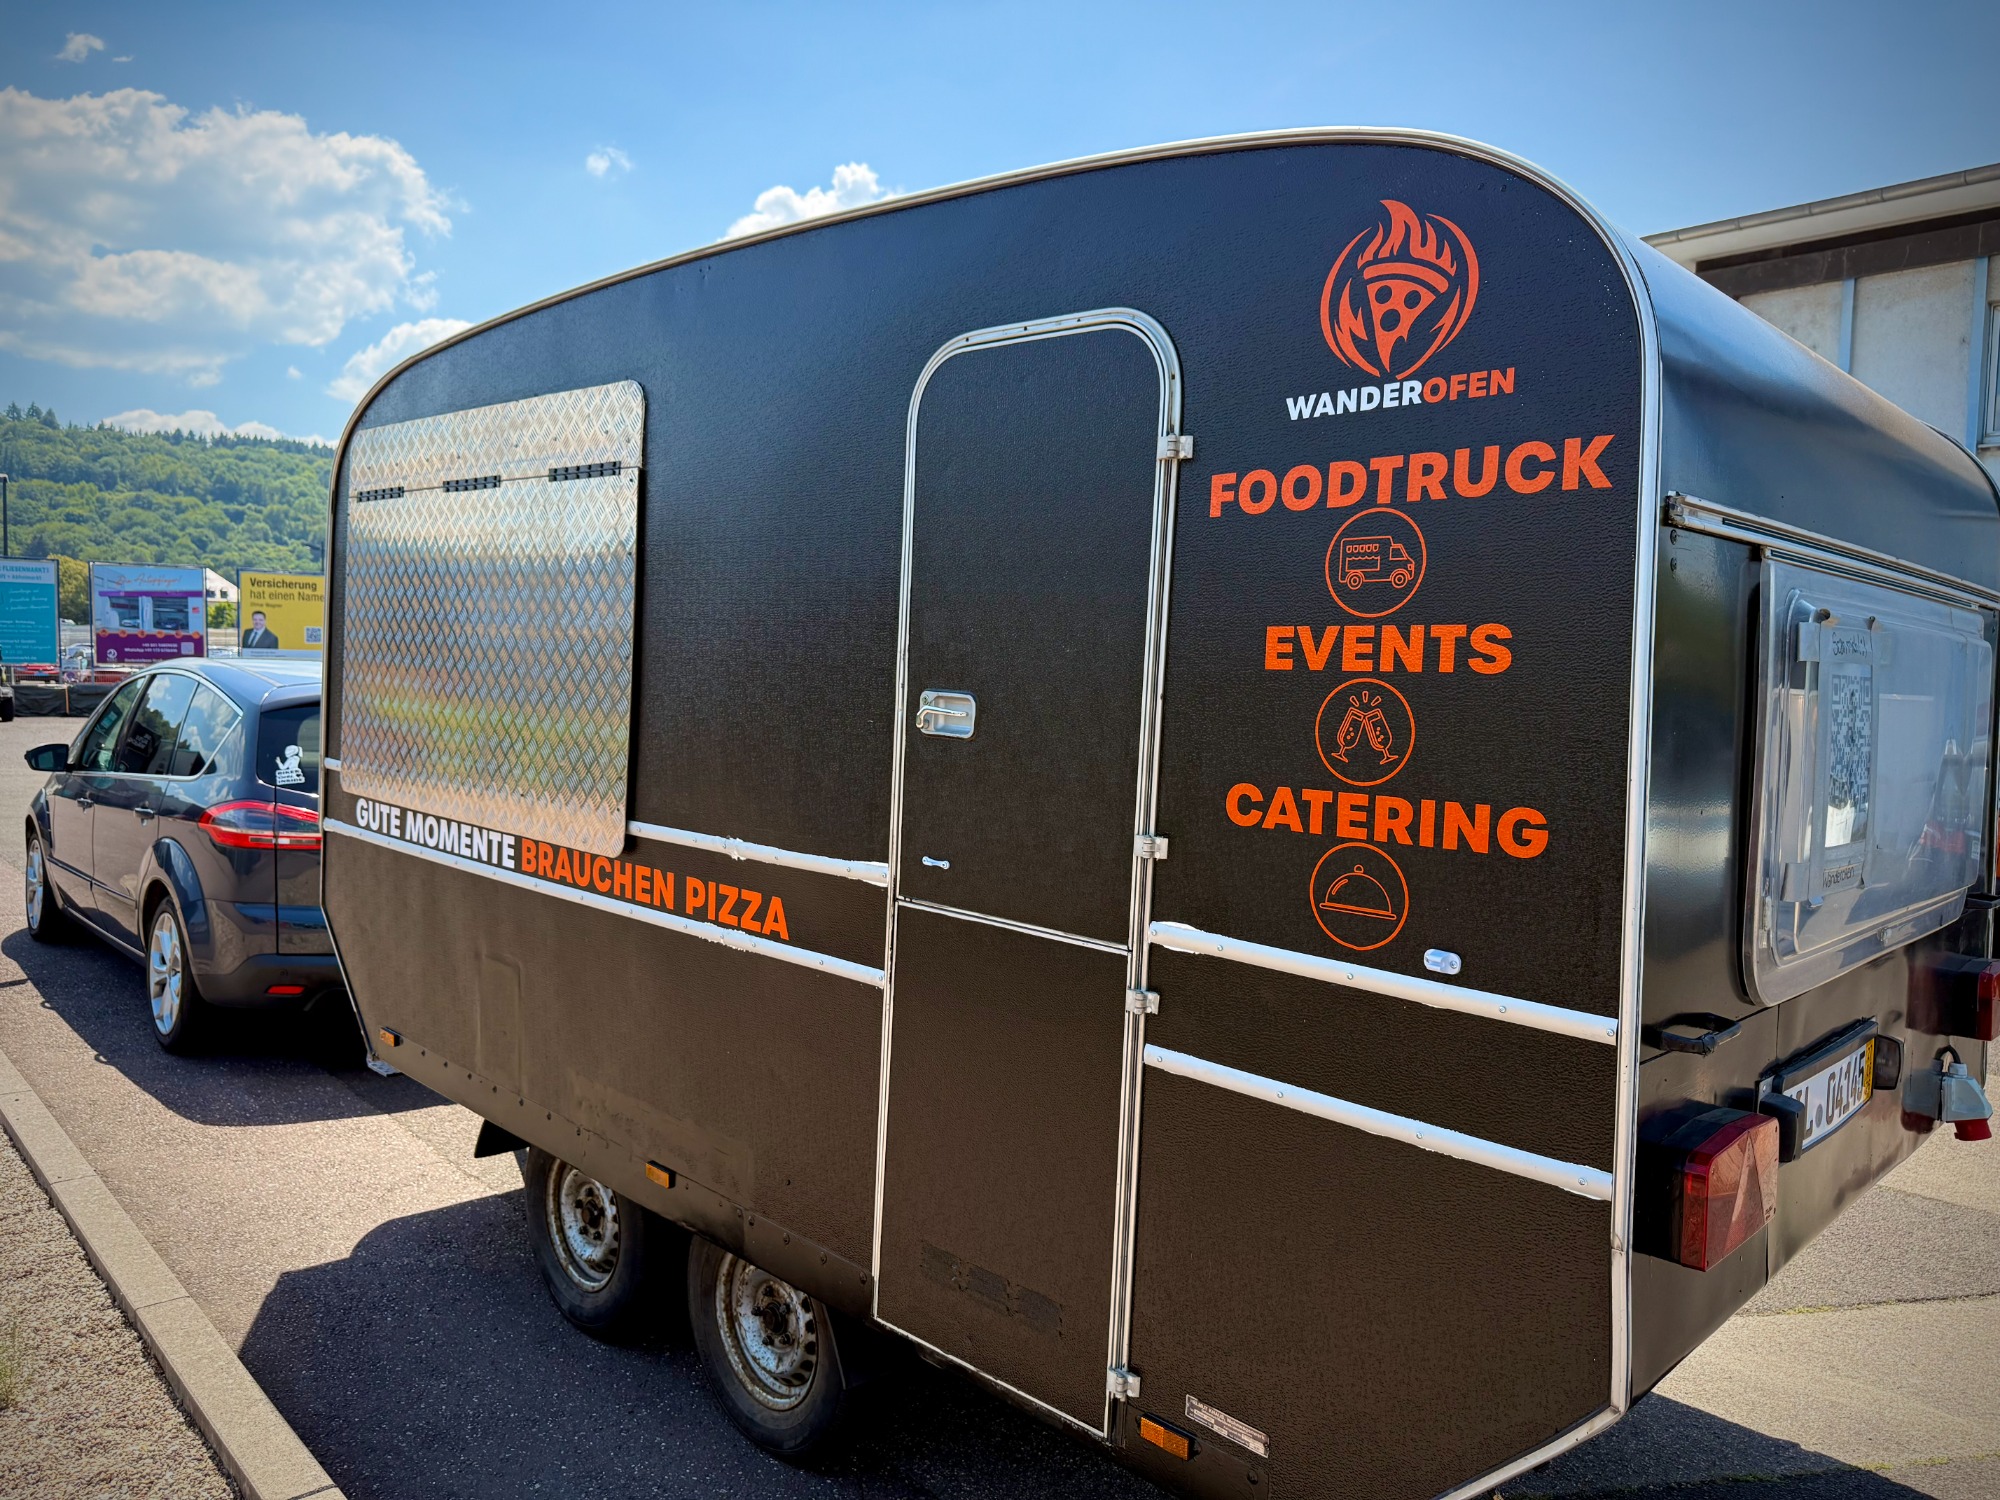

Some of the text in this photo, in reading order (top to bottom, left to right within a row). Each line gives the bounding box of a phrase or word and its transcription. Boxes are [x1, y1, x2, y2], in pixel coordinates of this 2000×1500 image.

[1286, 367, 1515, 420] WANDEROFEN
[1209, 434, 1615, 518] FOODTRUCK
[250, 578, 317, 591] Versicherung
[250, 590, 265, 600] hat
[269, 591, 295, 601] einen
[1265, 623, 1513, 675] EVENTS
[1225, 782, 1549, 859] CATERING
[356, 798, 790, 941] GUTE MOMENTE BRAUCHEN PIZZA
